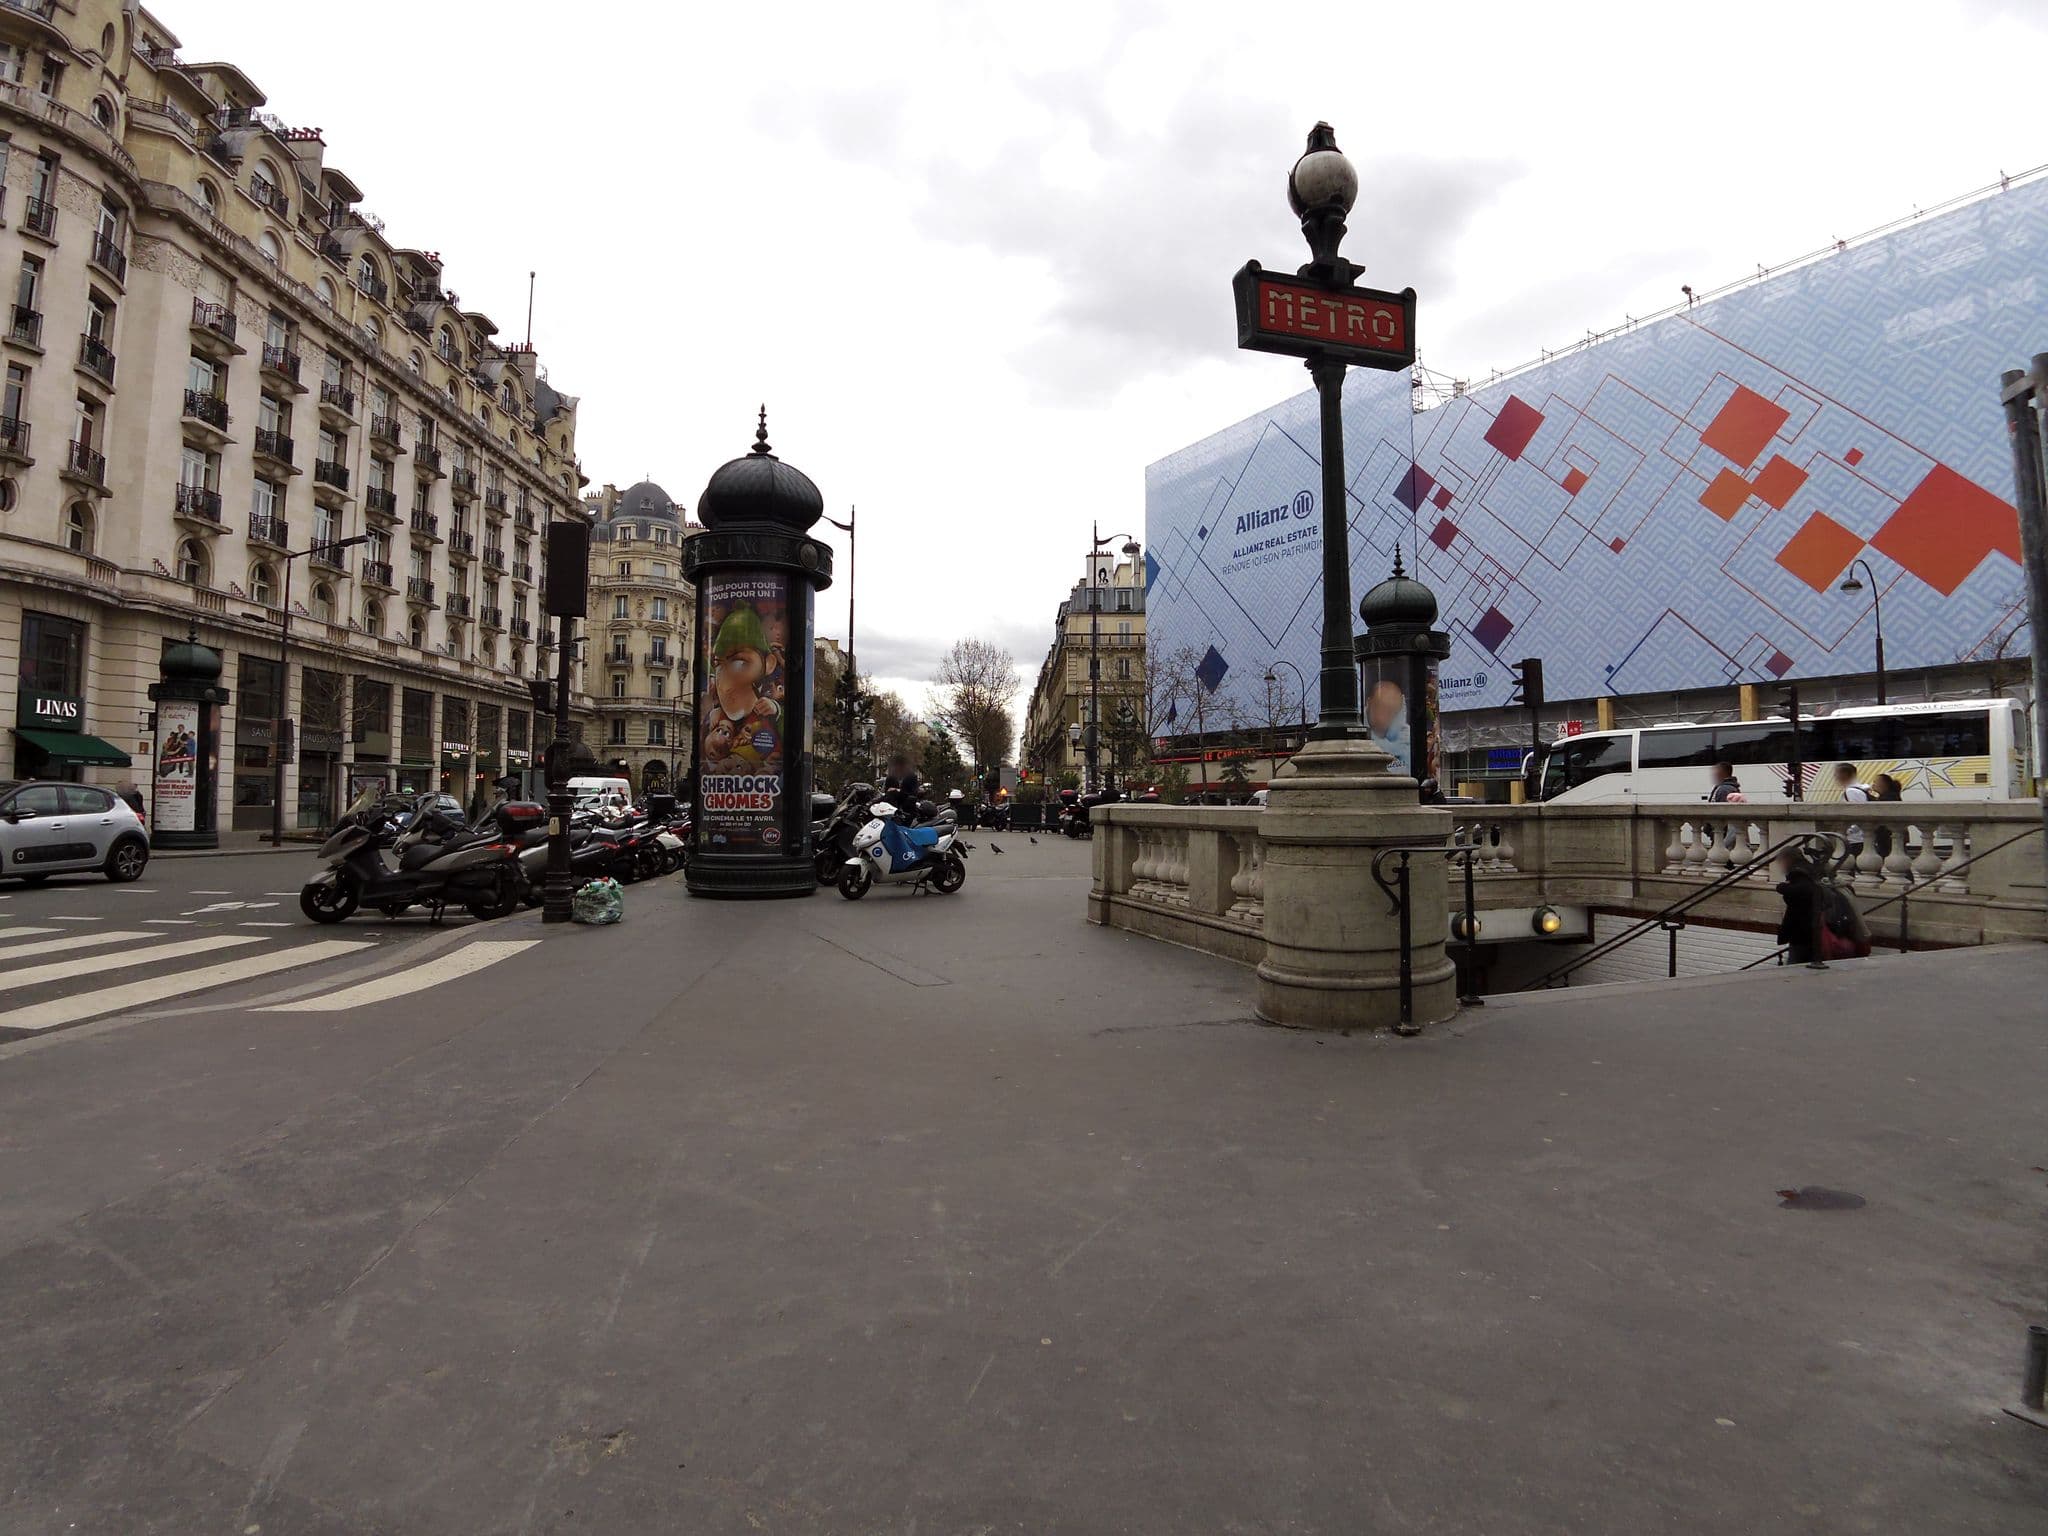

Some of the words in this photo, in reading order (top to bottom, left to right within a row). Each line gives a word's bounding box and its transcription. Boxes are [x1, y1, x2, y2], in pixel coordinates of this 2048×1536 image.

[1268, 290, 1396, 342] METRO
[1235, 504, 1289, 535] Allianz
[1232, 542, 1264, 559] ALLIANZ
[1265, 536, 1286, 550] REAL
[1287, 525, 1318, 543] ESTATE
[1263, 552, 1280, 565] SON
[1281, 538, 1322, 558] PATRIMOI
[710, 591, 729, 601] TOUS
[730, 590, 755, 599] POUR
[757, 590, 770, 598] UN
[725, 582, 749, 590] POUR
[1438, 677, 1472, 690] Allianz
[35, 698, 77, 718] LINAS
[702, 776, 780, 794] SHERLOCK
[705, 793, 772, 810] GNOMES
